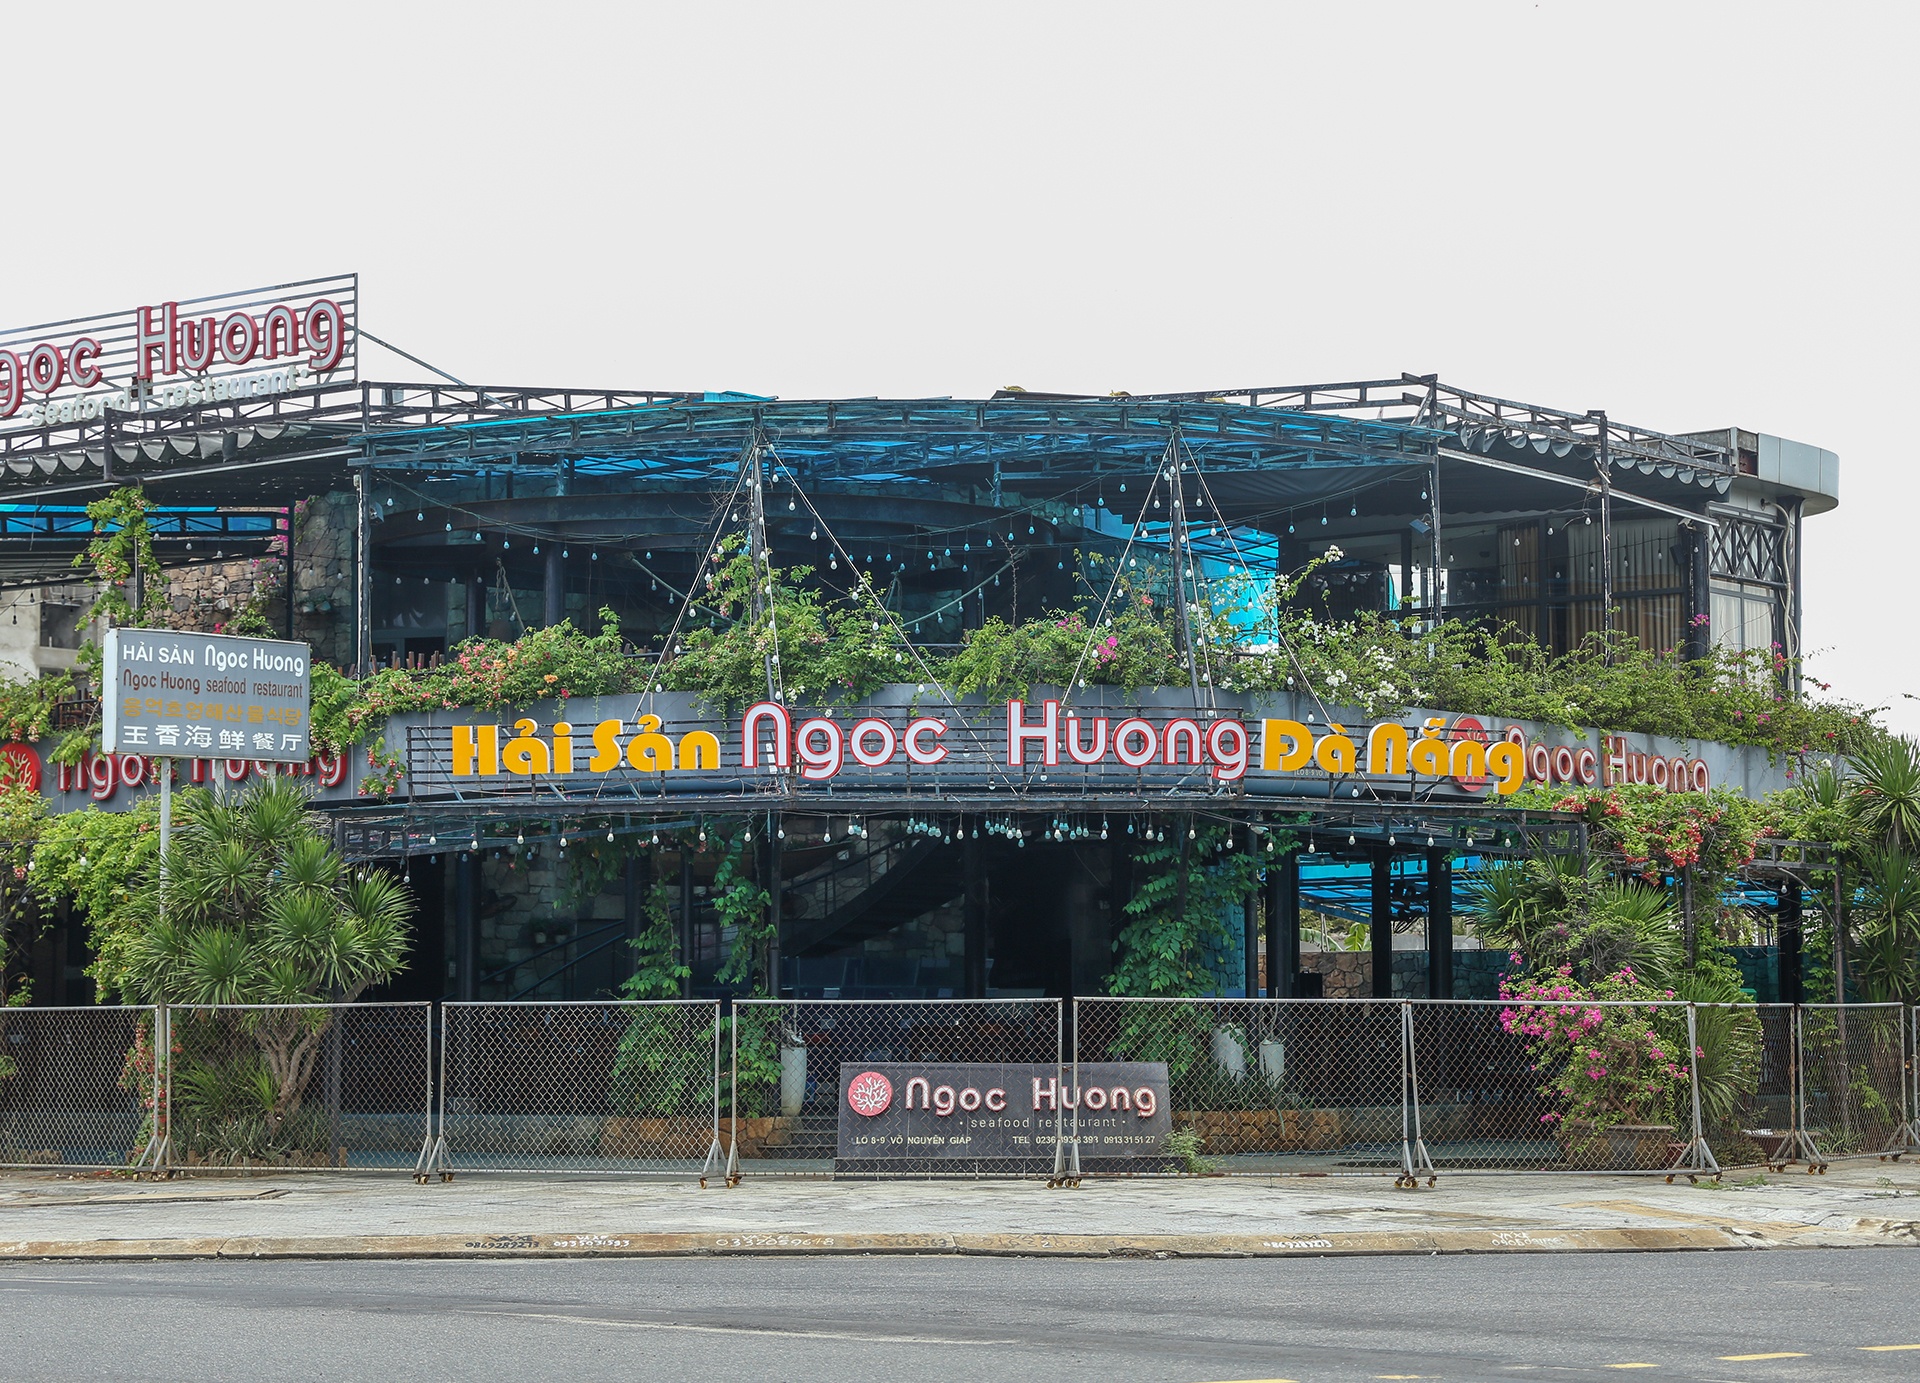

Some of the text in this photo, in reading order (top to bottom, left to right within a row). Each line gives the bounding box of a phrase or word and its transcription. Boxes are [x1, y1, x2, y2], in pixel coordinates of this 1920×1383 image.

[136, 298, 345, 380] Huong
[32, 365, 299, 427] seafood restaurant
[122, 641, 304, 678] HẢI SẢN Ngoc Huong
[123, 668, 303, 699] Ngoc Huong seafood restaurant
[122, 724, 303, 752] 玉香海鲜餐厅
[451, 699, 1526, 796] Hải Sản Ngoc Huong Đà Nẵng
[1602, 735, 1710, 795] Huong
[905, 1076, 1158, 1119] Ngoc Huong
[971, 1117, 1030, 1128] seafood
[1012, 1135, 1030, 1144] TEL
